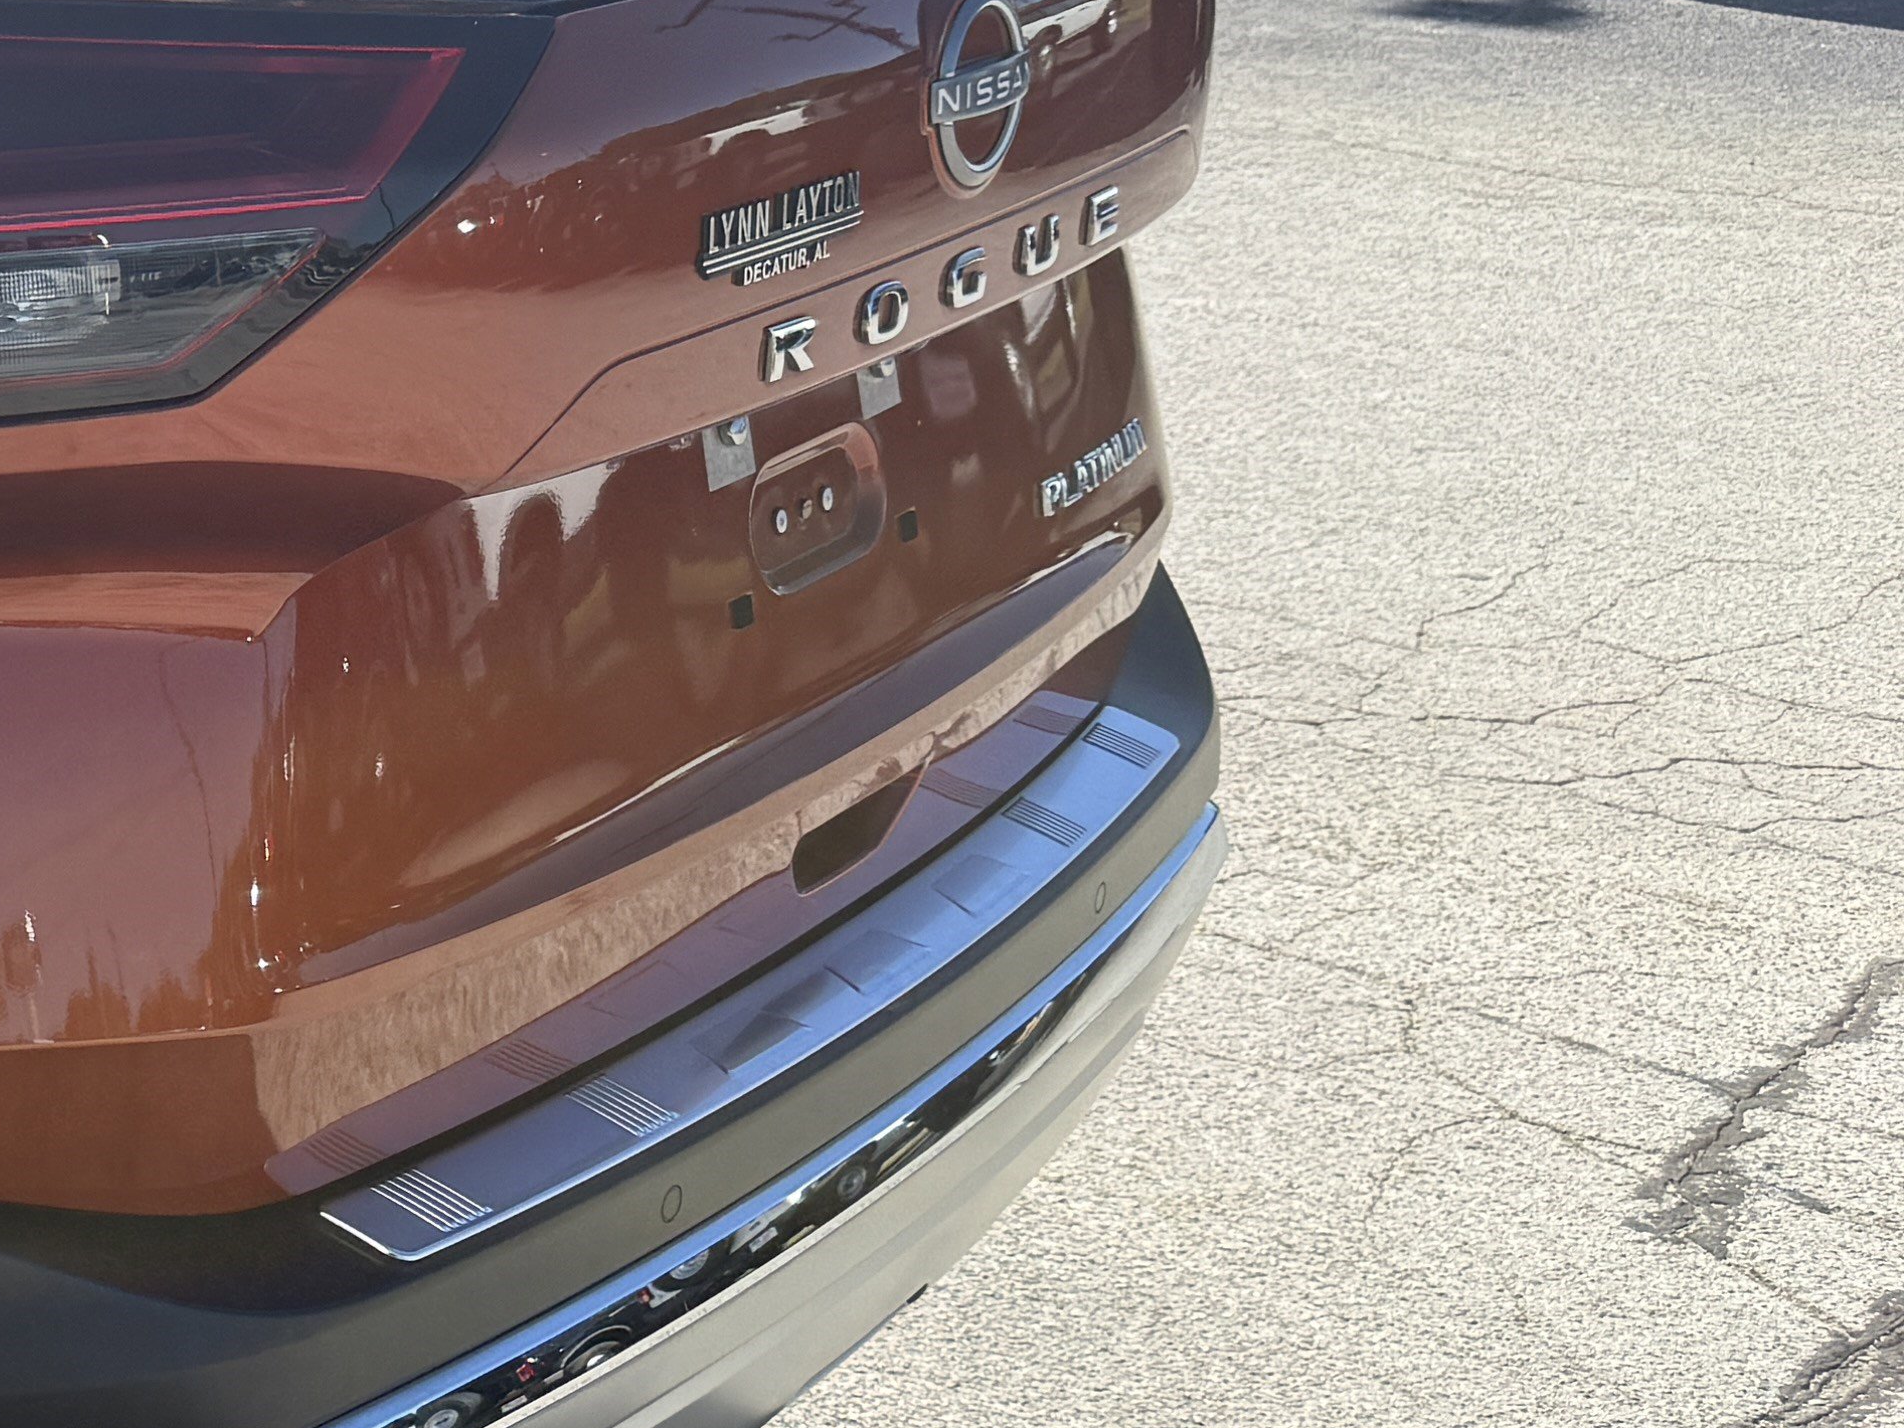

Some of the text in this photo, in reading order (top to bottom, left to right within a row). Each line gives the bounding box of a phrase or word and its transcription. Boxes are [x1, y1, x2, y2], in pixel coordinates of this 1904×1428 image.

[708, 170, 861, 254] LYNN LAYTON
[743, 240, 831, 286] DECATUR, AL
[761, 184, 1120, 384] ROGUE
[1039, 417, 1148, 517] PLATINUM
